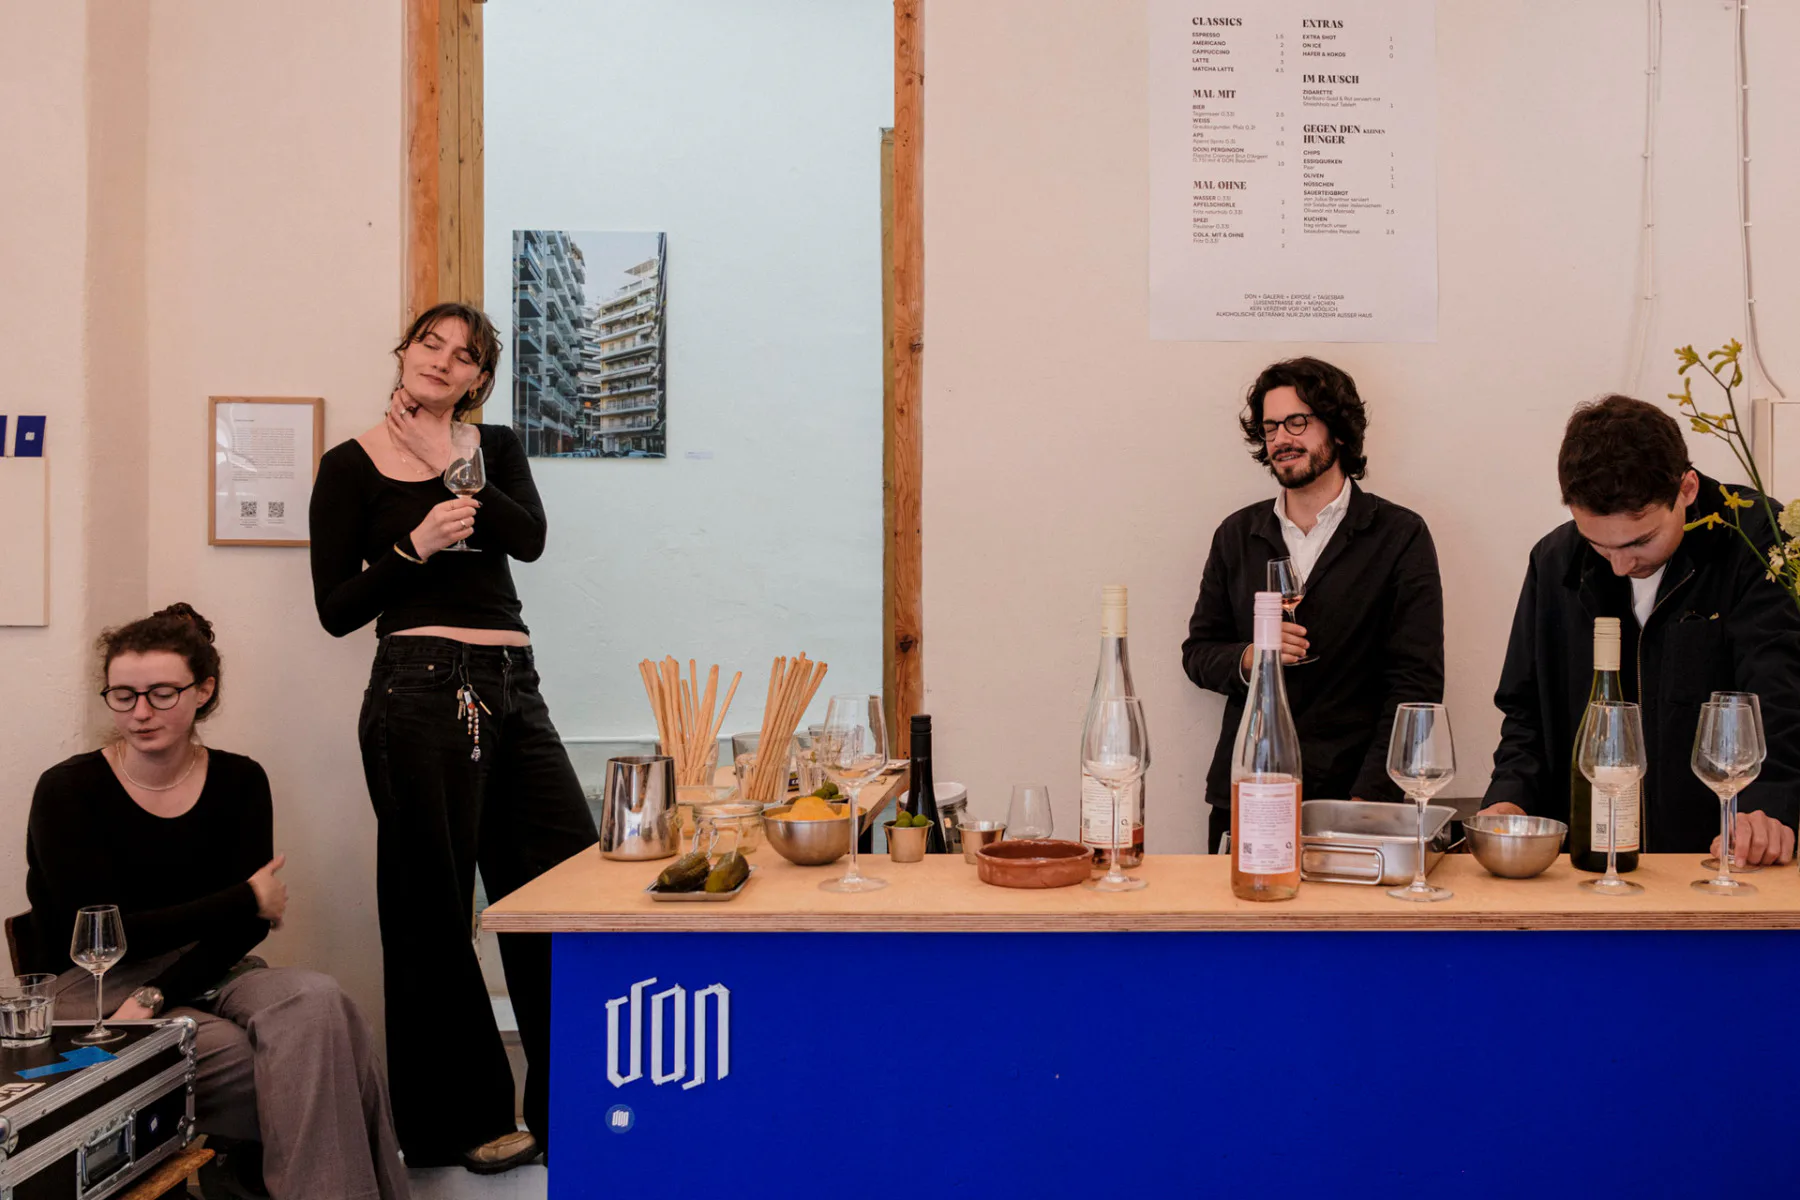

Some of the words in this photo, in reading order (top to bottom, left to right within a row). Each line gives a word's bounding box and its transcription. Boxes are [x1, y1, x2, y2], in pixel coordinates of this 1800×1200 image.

[1192, 17, 1242, 26] CLASSICS
[1302, 19, 1344, 28] EXTRAS
[1303, 74, 1315, 83] IM
[1318, 75, 1359, 84] RAUSCH
[1193, 90, 1215, 98] MAL
[1218, 90, 1236, 98] MIT
[1303, 124, 1337, 133] GEGEN
[1340, 124, 1361, 134] DEN
[1303, 135, 1345, 144] HUNGER
[1193, 181, 1215, 190] MAL
[1218, 181, 1247, 190] OHNE
